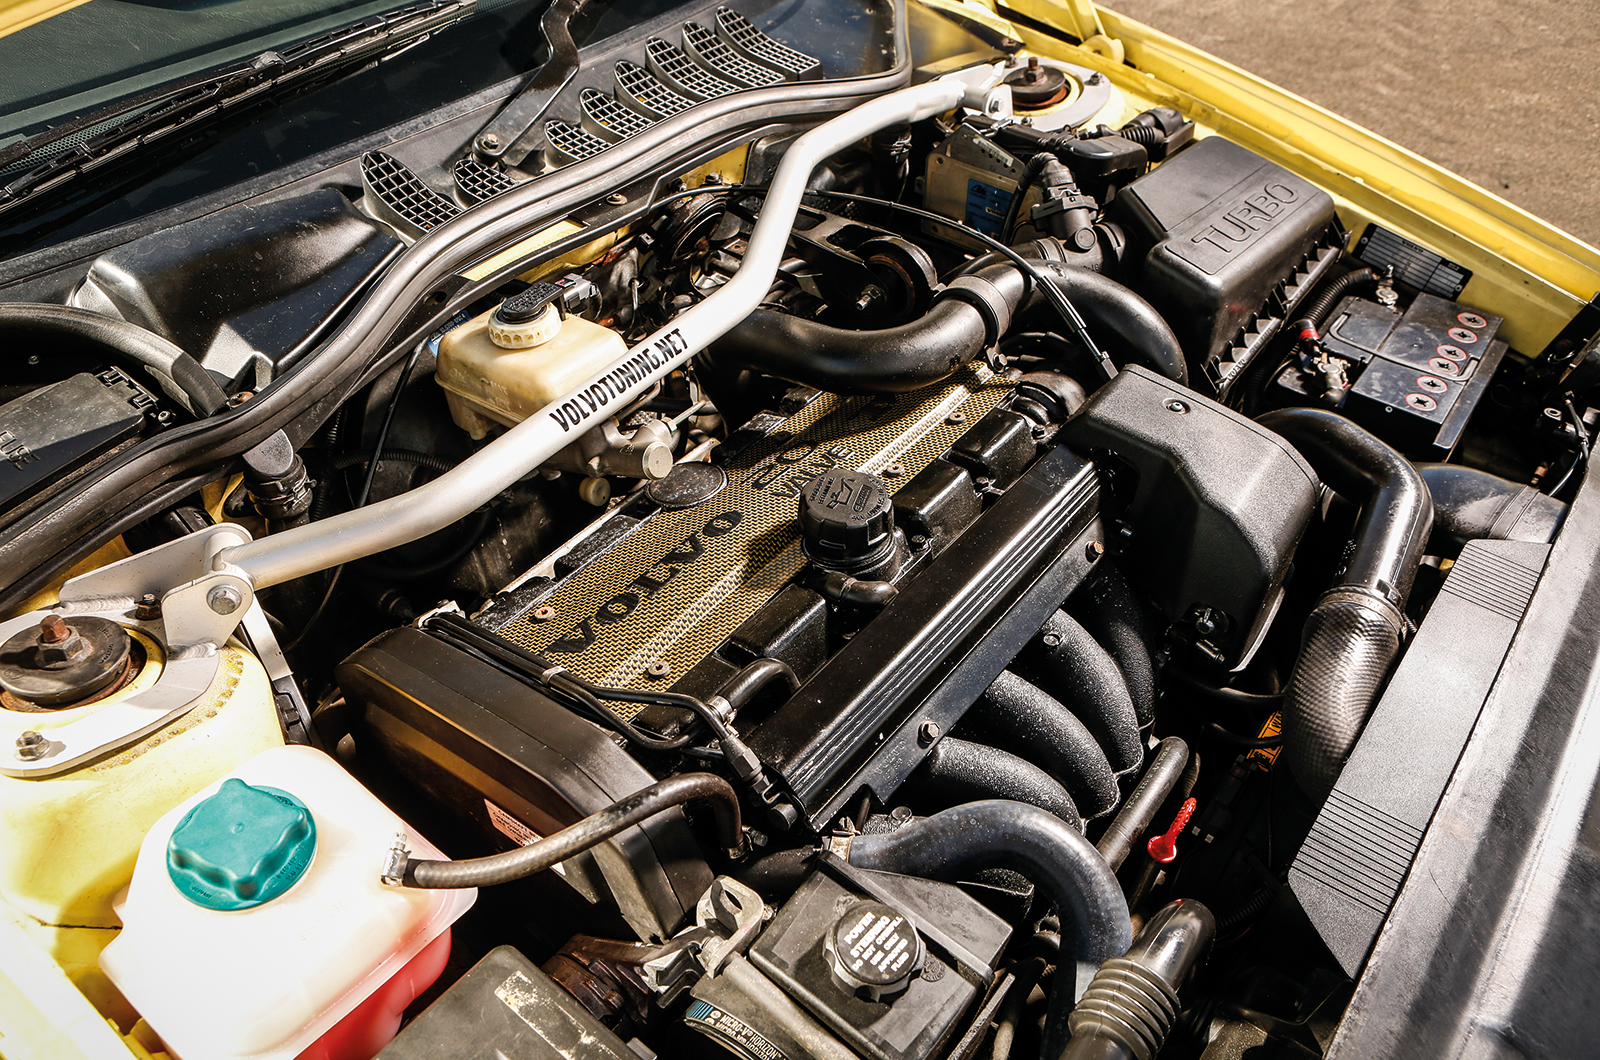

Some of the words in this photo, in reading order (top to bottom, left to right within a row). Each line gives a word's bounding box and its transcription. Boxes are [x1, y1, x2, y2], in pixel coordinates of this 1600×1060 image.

[1190, 183, 1299, 253] TURBO
[549, 328, 688, 432] VOLVOTUNING.NET
[541, 510, 743, 656] VOLVO
[843, 911, 876, 945] POWER
[849, 915, 891, 958] STEERING
[851, 958, 864, 972] DO
[861, 943, 876, 960] NOT
[877, 938, 909, 973] APPROVED
